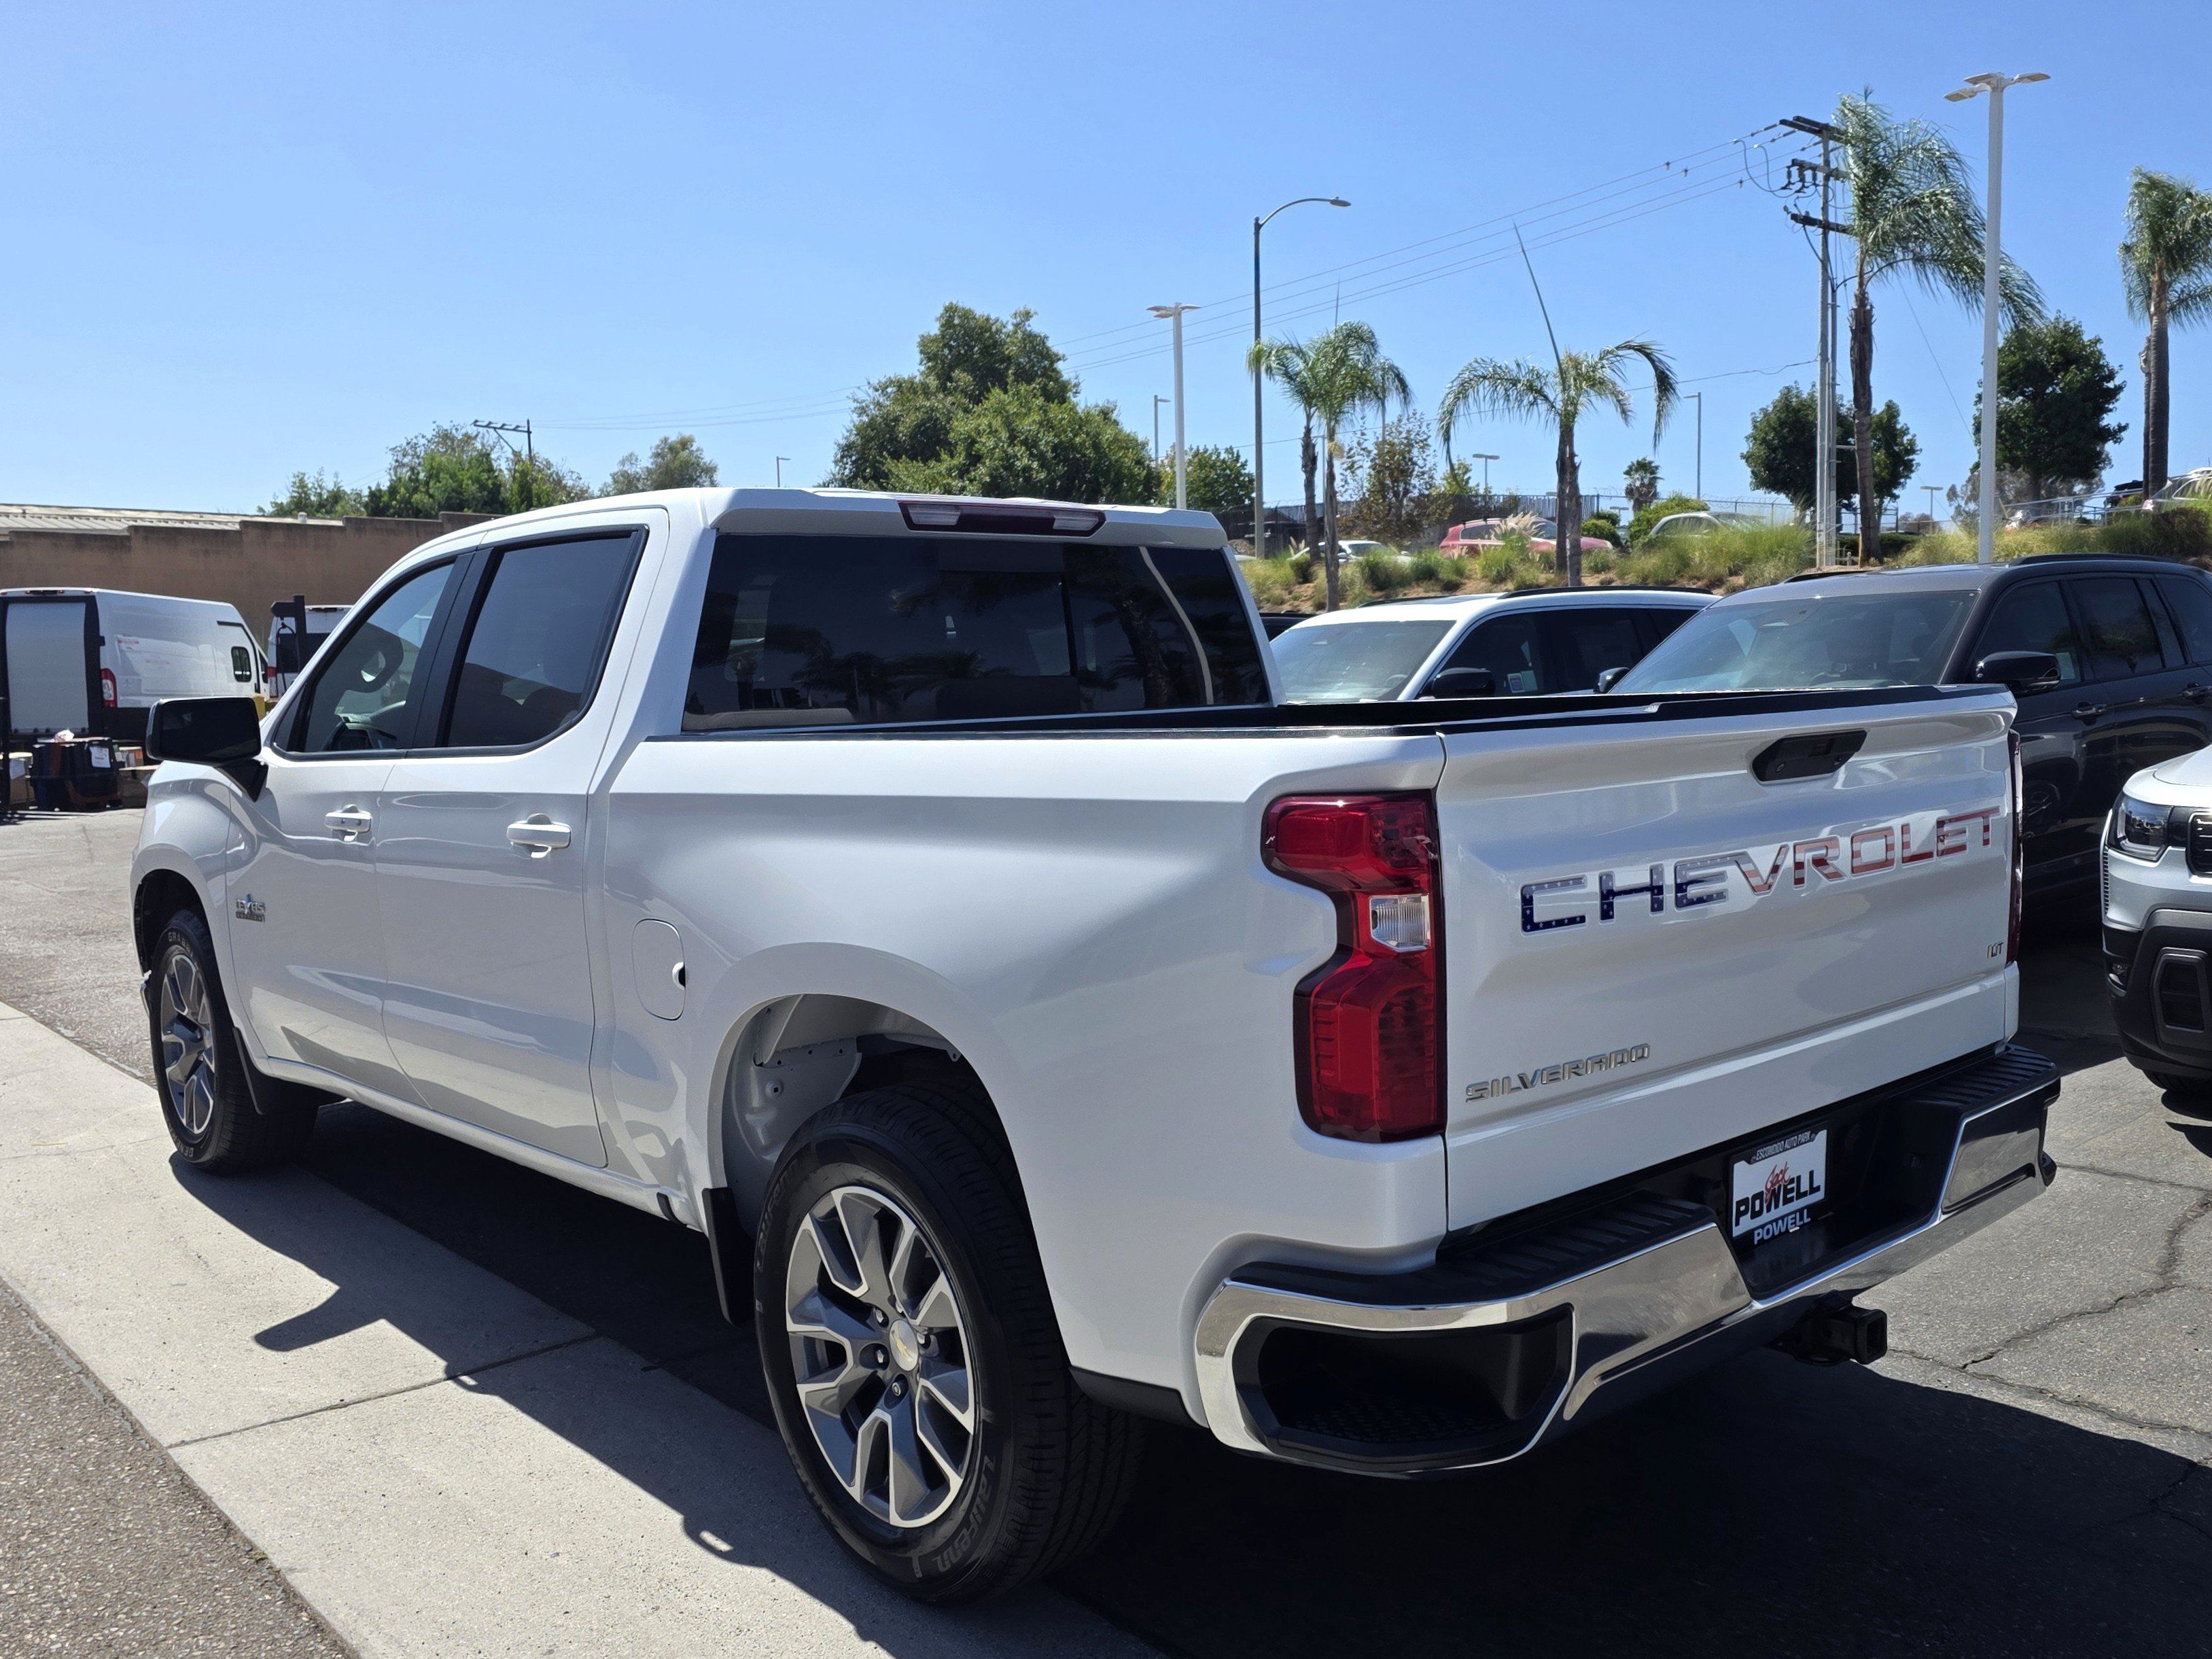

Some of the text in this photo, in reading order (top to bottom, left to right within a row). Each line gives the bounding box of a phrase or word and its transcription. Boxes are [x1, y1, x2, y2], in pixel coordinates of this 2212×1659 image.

[1521, 806, 2000, 933] CHEVROLET
[1987, 941, 2004, 958] LT
[1466, 1043, 1651, 1102] SILVERADO
[1735, 1170, 1821, 1227] POWELL
[1765, 1162, 1791, 1204] Jack
[1753, 1208, 1810, 1245] POWELL
